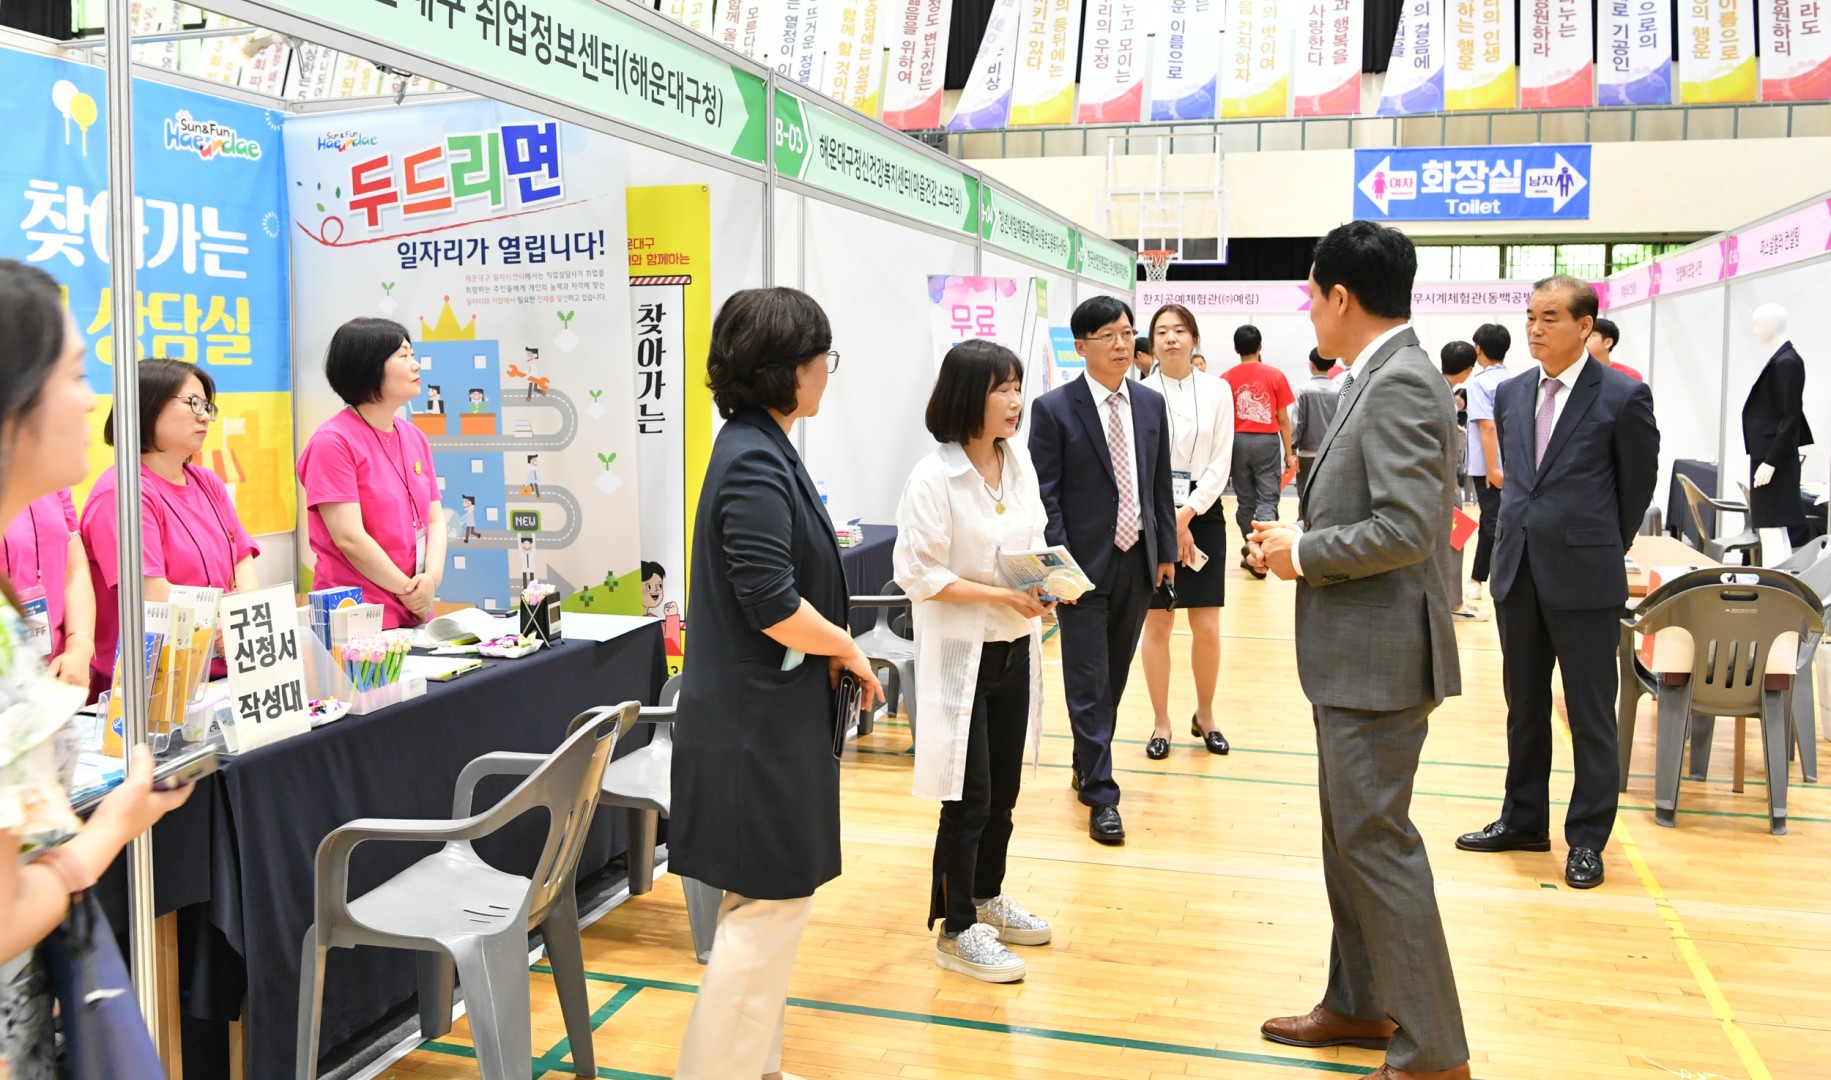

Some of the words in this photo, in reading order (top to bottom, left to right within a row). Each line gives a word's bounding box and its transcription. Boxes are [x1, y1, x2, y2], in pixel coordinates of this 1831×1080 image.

[781, 15, 798, 58] 열정이
[839, 7, 858, 37] 함께
[1029, 0, 1048, 34] 키고
[1308, 4, 1326, 66] 사랑한다
[1718, 0, 1740, 60] 이름으로
[1800, 1, 1821, 35] 라도
[838, 41, 854, 56] 할
[1027, 40, 1044, 70] 있다
[1049, 17, 1068, 78] 등뒤에는
[1093, 38, 1111, 69] 우정
[1166, 19, 1185, 79] 이름으로
[1234, 21, 1253, 82] 간직하자
[1259, 25, 1276, 70] 벗이여
[1332, 16, 1349, 65] 행복을
[1413, 22, 1431, 69] 걸음에
[1457, 38, 1475, 71] 행운
[1482, 30, 1500, 63] 인생
[1612, 24, 1630, 72] 기공인
[1692, 26, 1711, 59] 행운
[475, 0, 724, 127] 취업정보센터(해운대구청)
[897, 41, 916, 85] 위하여
[918, 31, 937, 91] 변치않는
[985, 61, 1001, 90] 비상
[1115, 38, 1133, 84] 모이는
[853, 64, 870, 108] 성공과
[165, 119, 260, 159] Haeundae
[181, 118, 231, 139] Sun&Fun
[317, 134, 378, 153] Haeundae
[775, 117, 804, 154] B-03
[347, 120, 565, 228] 두드리면
[819, 133, 938, 207] 해운대구정신건강복지센터(마음건강
[1389, 177, 1414, 188] 여자
[1420, 159, 1522, 194] 화장실
[1529, 174, 1555, 188] 남자
[1445, 198, 1501, 214] Toilet
[396, 237, 490, 269] 일자리가
[498, 230, 605, 265] 열립니다!
[629, 254, 643, 266] 와
[647, 253, 690, 266] 함께하는
[465, 274, 490, 283] 해운대구
[493, 272, 543, 282] 일자리센터에서는
[547, 271, 583, 280] 직업상담사가
[586, 269, 605, 278] 취업을
[465, 286, 490, 294] 희망하는
[529, 284, 547, 292] 개인의
[466, 297, 490, 306] 일자리와
[492, 296, 516, 305] 기업에서
[517, 295, 535, 304] 필요한
[87, 287, 252, 366] 상담실
[950, 304, 997, 337] 무료
[635, 302, 667, 434] 찾아가는
[515, 516, 536, 527] NEW
[229, 601, 272, 640] 구직
[234, 629, 298, 675] 신청서
[238, 679, 304, 724] 작성대
